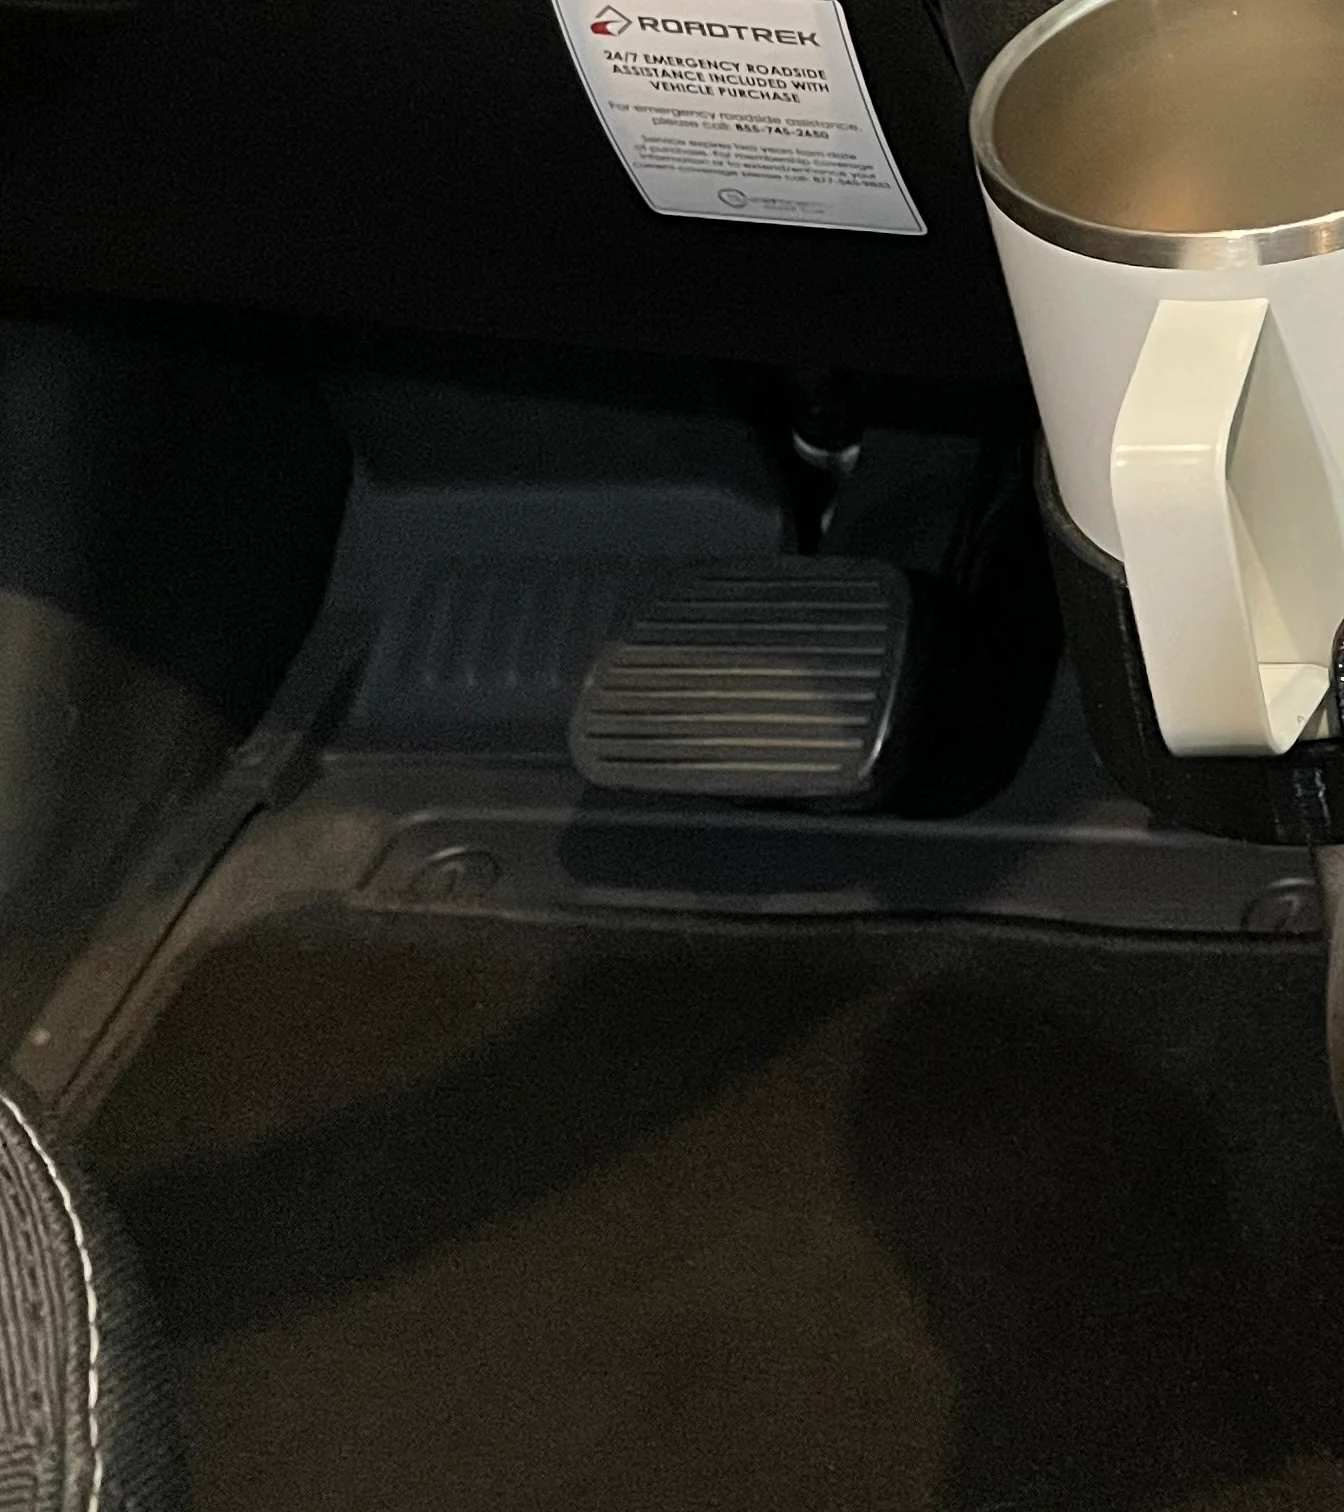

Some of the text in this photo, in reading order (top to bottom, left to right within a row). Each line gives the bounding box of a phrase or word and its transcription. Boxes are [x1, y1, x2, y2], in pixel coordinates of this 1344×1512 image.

[637, 16, 821, 47] ROADTREK
[603, 50, 828, 81] 24/7 EMERGENCY ROADSIDE
[612, 64, 830, 93] ASSISTANCE INCLUDED WITH
[650, 80, 802, 104] VEHICLE PURCHASE
[634, 105, 716, 120] emergency
[719, 112, 782, 125] roadside
